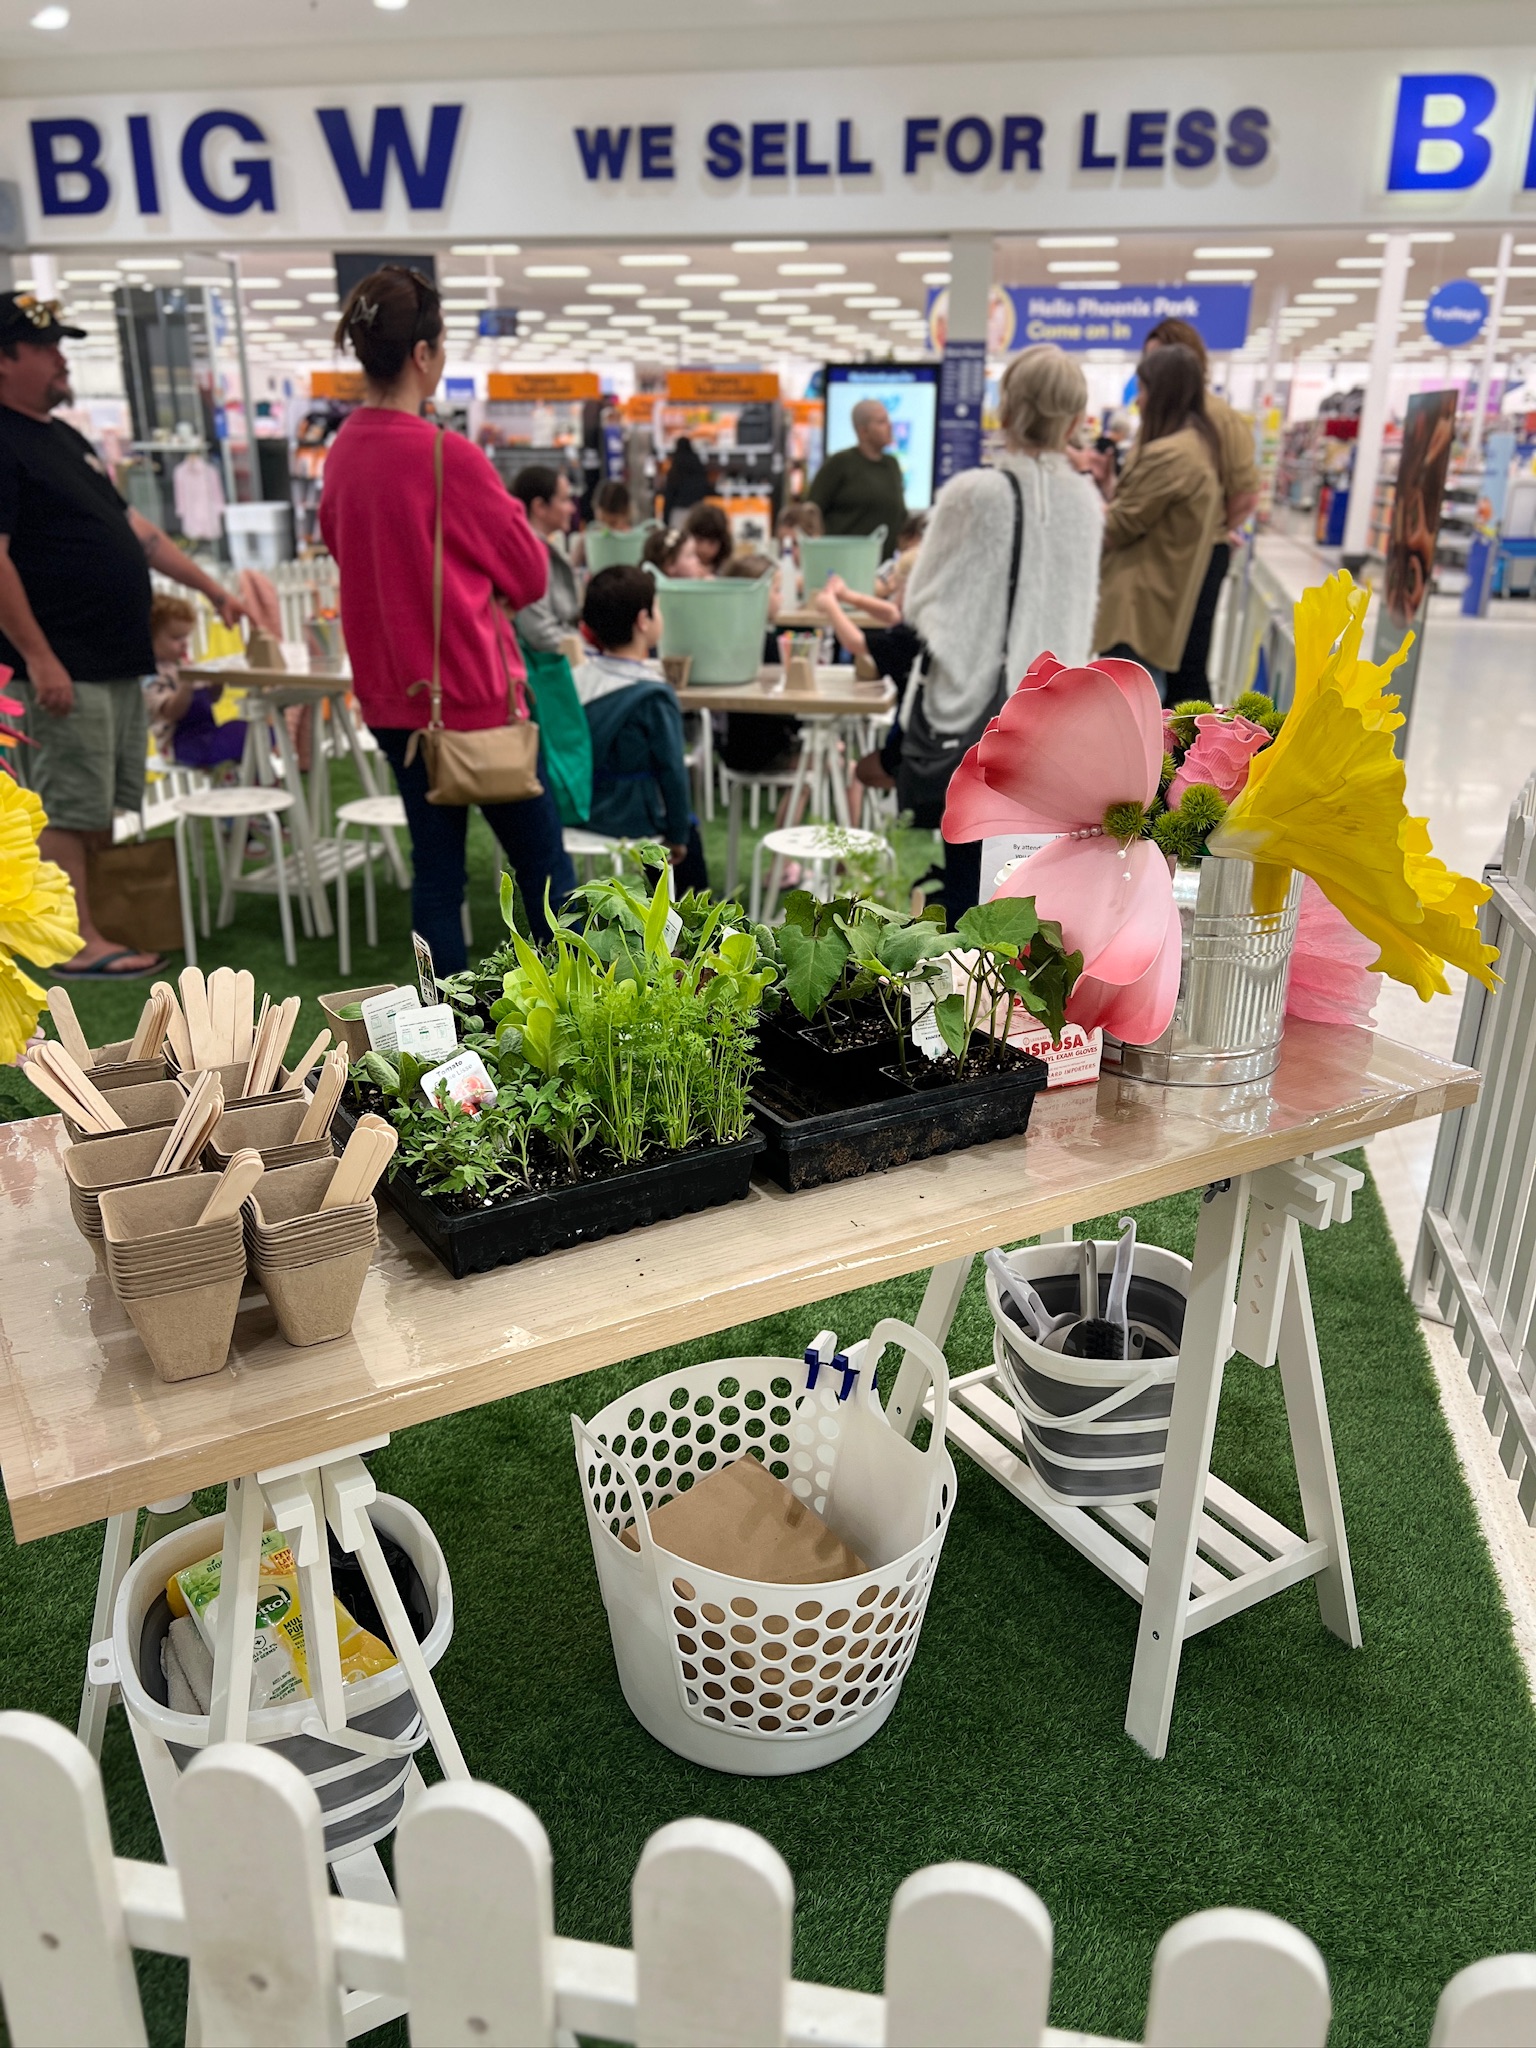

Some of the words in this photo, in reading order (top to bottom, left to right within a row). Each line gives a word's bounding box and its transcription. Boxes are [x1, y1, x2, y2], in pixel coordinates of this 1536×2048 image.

[576, 129, 674, 179] WE
[705, 120, 873, 179] SELL
[905, 116, 1045, 175] FOR
[1079, 107, 1270, 170] LESS
[31, 110, 276, 215] BIG
[318, 106, 462, 210] W
[1028, 297, 1075, 318] Hello
[1077, 297, 1149, 318] Phoenix
[1153, 296, 1199, 318] Park
[1026, 320, 1081, 341] Come
[1112, 319, 1131, 339] in
[1056, 1052, 1074, 1061] EXAM
[1075, 1046, 1098, 1057] GLOVES
[436, 1060, 463, 1077] Tomato
[1064, 1063, 1096, 1075] IMPORTERS
